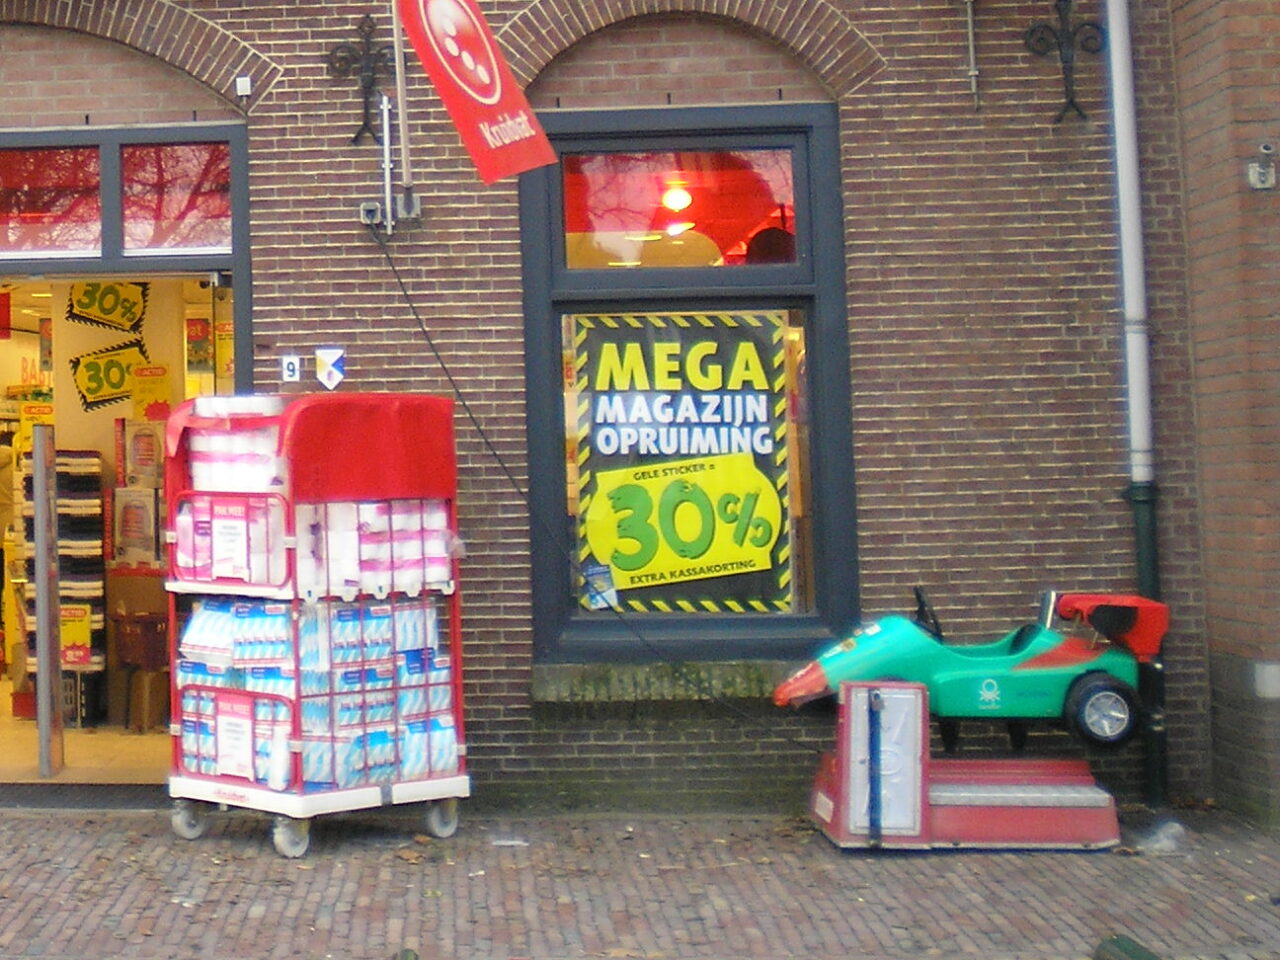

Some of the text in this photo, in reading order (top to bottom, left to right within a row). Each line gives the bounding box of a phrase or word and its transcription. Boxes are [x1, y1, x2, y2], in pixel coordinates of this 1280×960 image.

[479, 110, 536, 149] Kruidvat
[83, 359, 133, 395] 30
[286, 361, 296, 378] 9
[595, 341, 769, 391] MEGA
[596, 394, 767, 426] MAGAZIJN
[596, 426, 773, 455] OPRUIMING
[633, 469, 660, 481] GELE
[662, 463, 707, 477] STICKER
[607, 479, 773, 572] 30%
[629, 560, 756, 585] EXTRA KASSAKORTING
